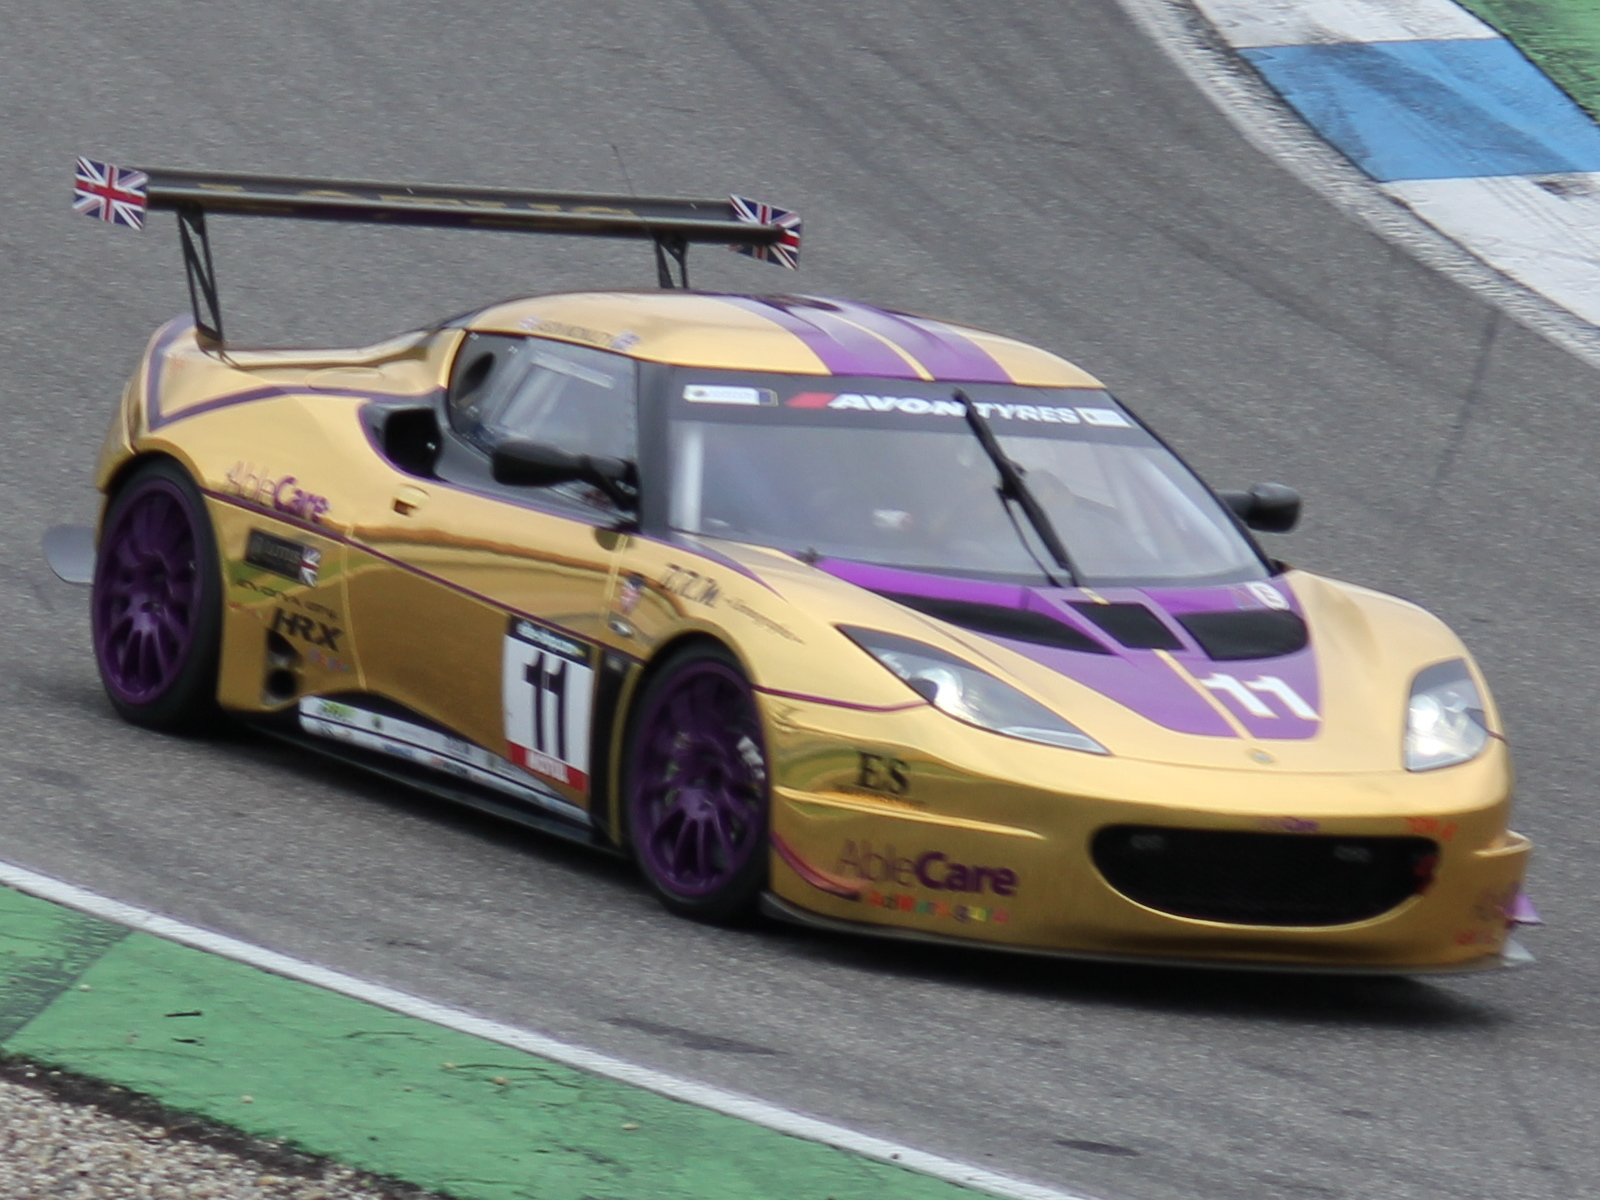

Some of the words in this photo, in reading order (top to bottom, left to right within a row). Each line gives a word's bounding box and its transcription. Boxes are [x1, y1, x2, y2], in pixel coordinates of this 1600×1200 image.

[828, 393, 967, 418] AVON
[972, 402, 1082, 424] TYRES
[272, 607, 344, 652] HRX
[522, 651, 567, 762] 11
[1200, 672, 1322, 721] 11
[857, 751, 909, 794] ES
[834, 838, 1020, 897] AbleCare
